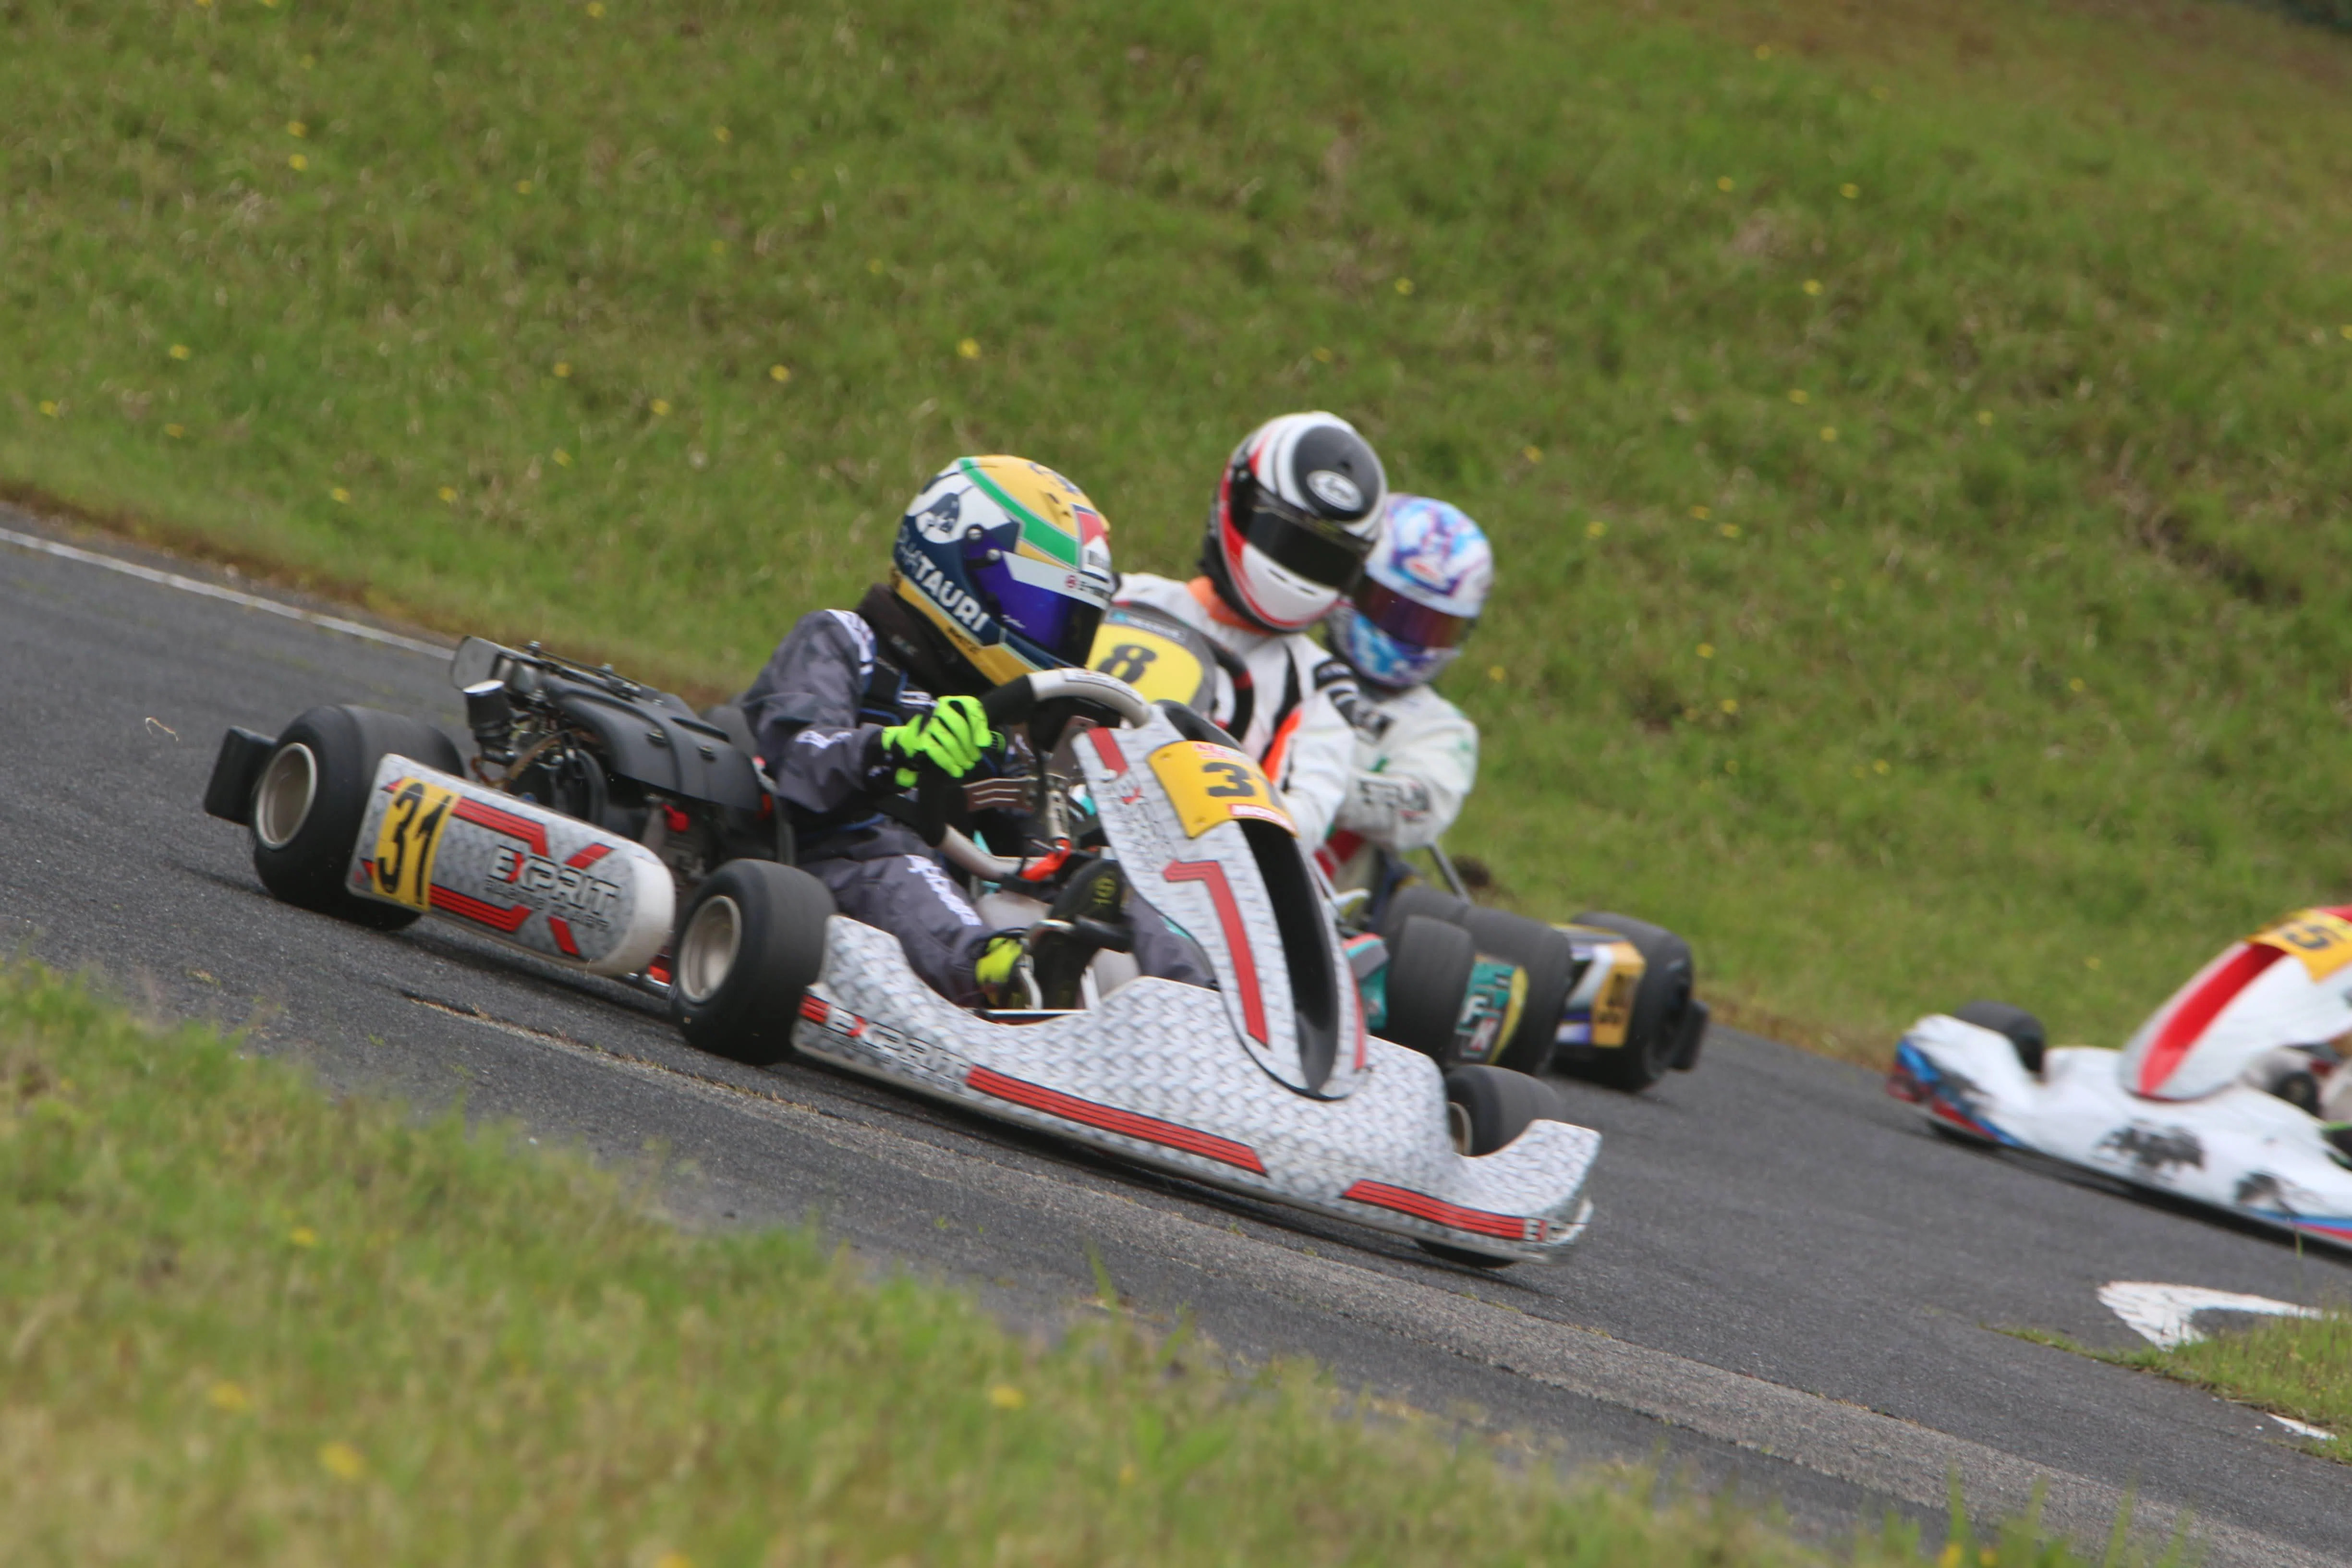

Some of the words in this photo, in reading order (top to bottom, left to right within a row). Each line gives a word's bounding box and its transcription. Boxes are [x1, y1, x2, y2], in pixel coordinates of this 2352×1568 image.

[915, 554, 991, 632] TAURI
[1097, 644, 1158, 684] 8
[378, 782, 452, 905] 31
